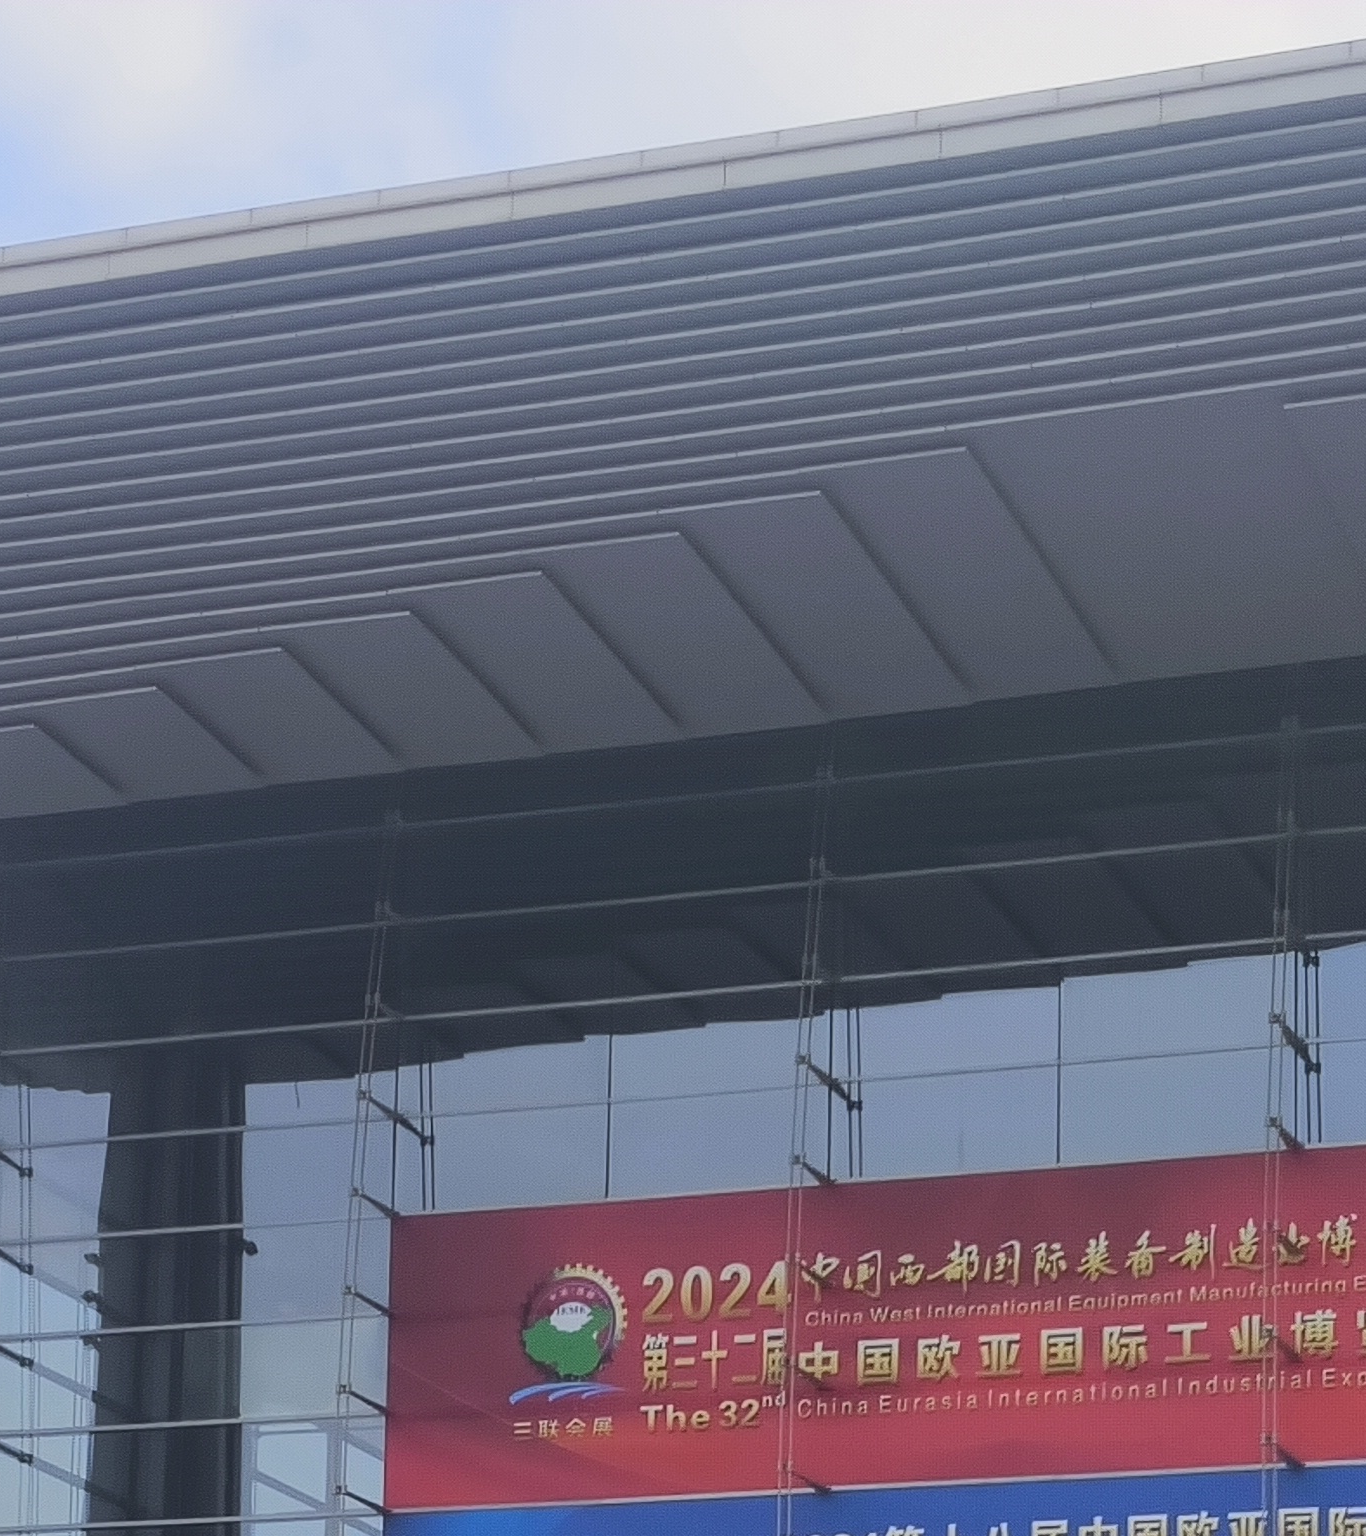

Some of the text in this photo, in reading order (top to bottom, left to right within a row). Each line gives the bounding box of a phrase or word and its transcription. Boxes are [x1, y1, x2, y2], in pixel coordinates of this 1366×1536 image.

[642, 1259, 792, 1324] 2024
[804, 1309, 863, 1328] China
[869, 1306, 922, 1324] West
[927, 1296, 1062, 1320] International
[1068, 1288, 1183, 1313] Equipment
[1189, 1277, 1348, 1303] Manufacturing
[642, 1328, 788, 1394] 第三十二届
[513, 1416, 613, 1440] 三联会展
[640, 1402, 714, 1432] The
[797, 1397, 869, 1419] China
[878, 1391, 978, 1413] Eurasia
[988, 1380, 1167, 1408] International
[1176, 1370, 1312, 1395] Industrial
